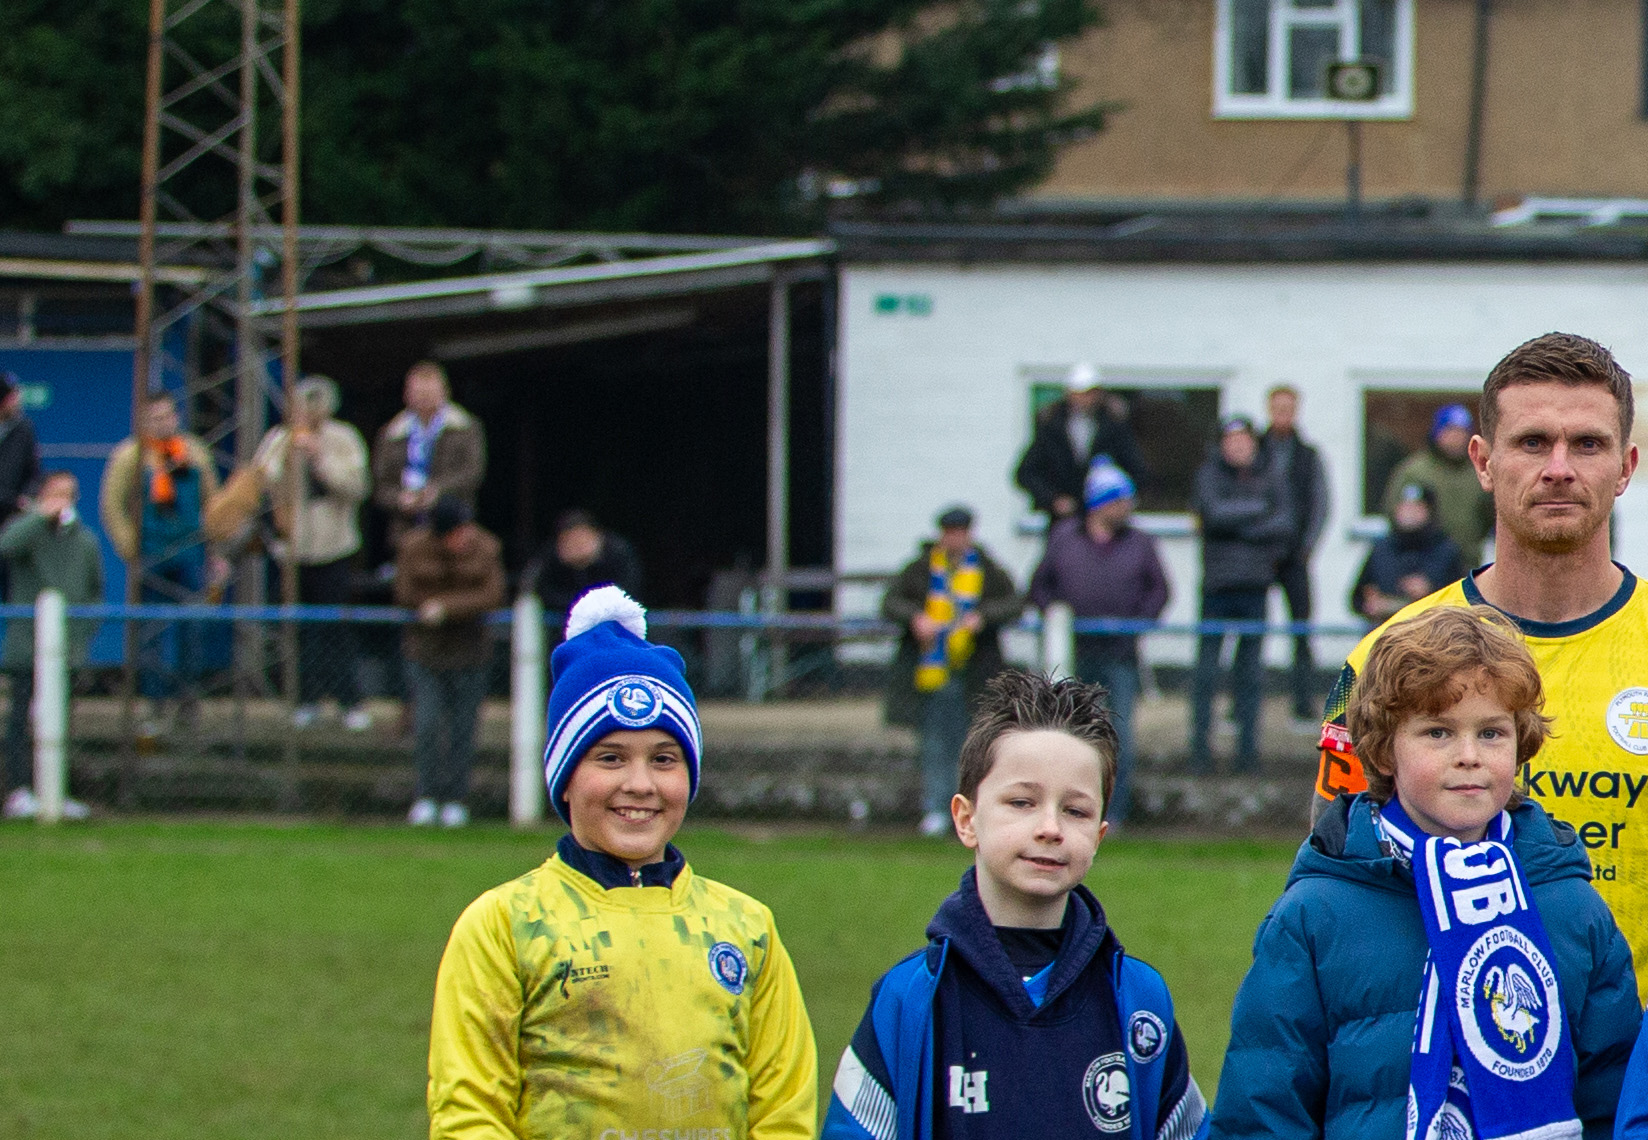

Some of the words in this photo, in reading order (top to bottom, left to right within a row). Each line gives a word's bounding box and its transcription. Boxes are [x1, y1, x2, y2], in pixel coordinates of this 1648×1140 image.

[1443, 836, 1518, 926] UB
[1592, 865, 1617, 881] td
[1461, 944, 1486, 1009] MARLOW
[1485, 929, 1530, 954] FOOTBALL
[1530, 952, 1555, 989] CLUB
[1491, 1061, 1536, 1079] FOUNDED
[1536, 1047, 1554, 1070] 1870
